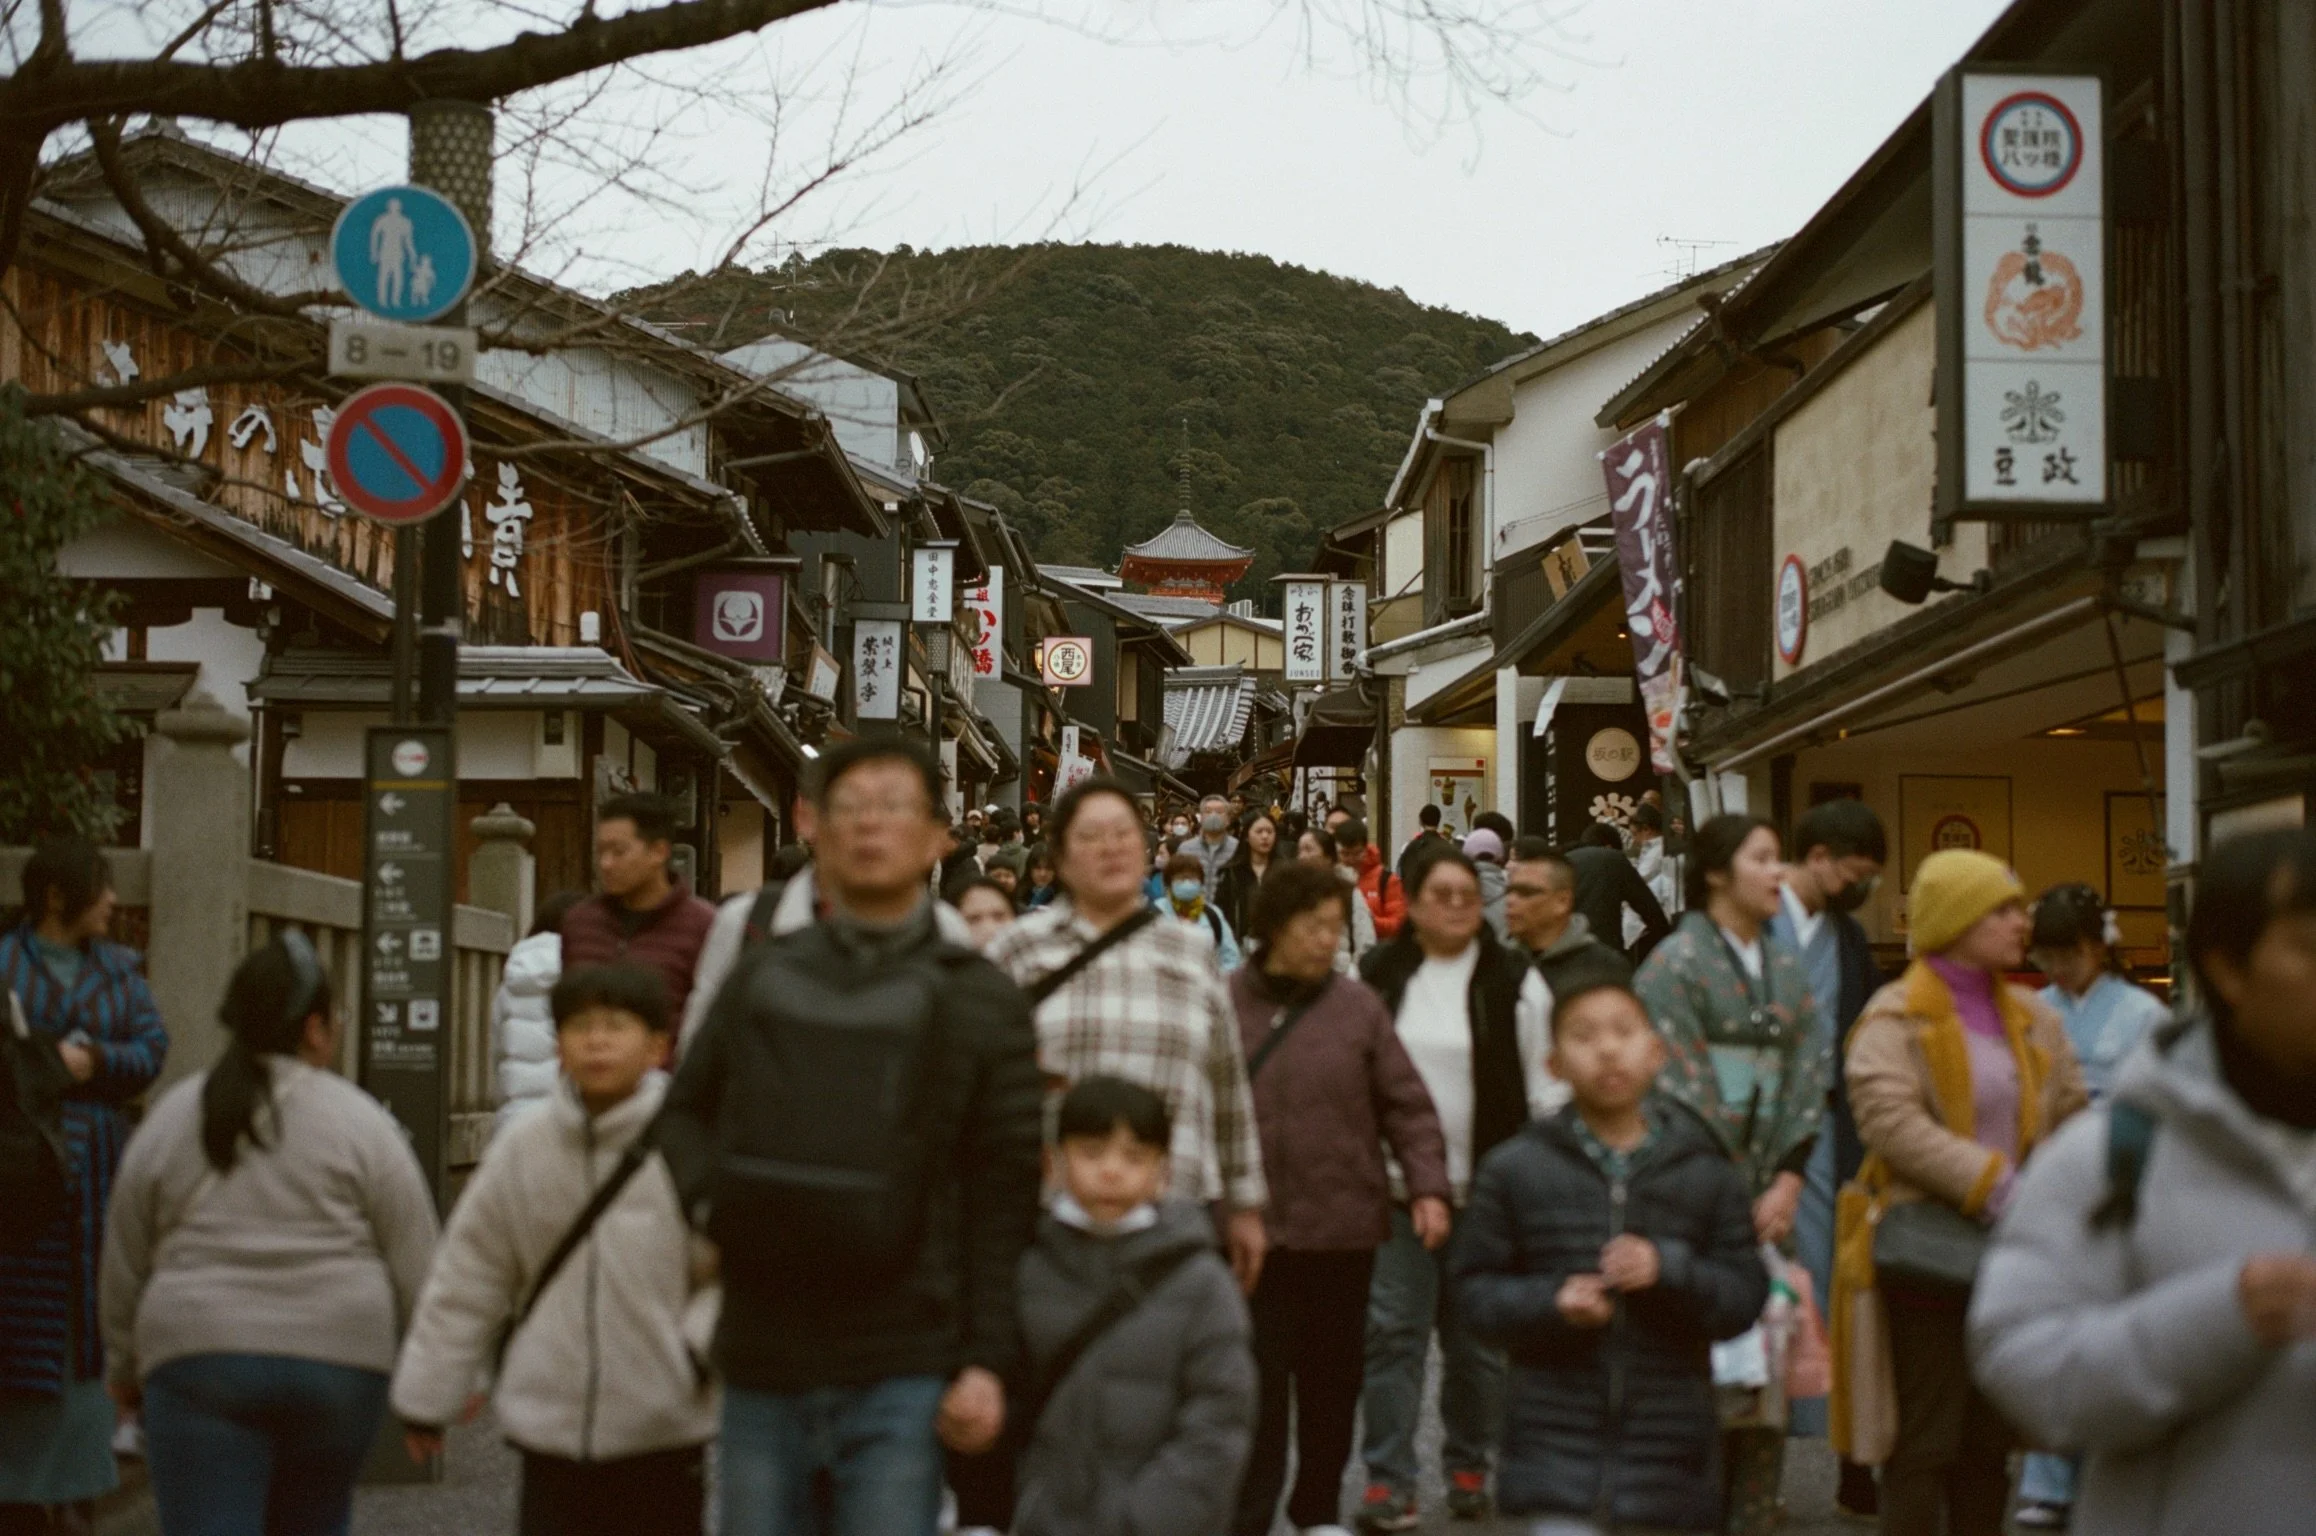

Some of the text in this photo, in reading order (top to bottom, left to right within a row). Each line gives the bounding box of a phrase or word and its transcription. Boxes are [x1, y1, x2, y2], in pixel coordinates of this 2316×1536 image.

[1614, 449, 1671, 676] ラーメン
[1060, 647, 1075, 675] 西尾
